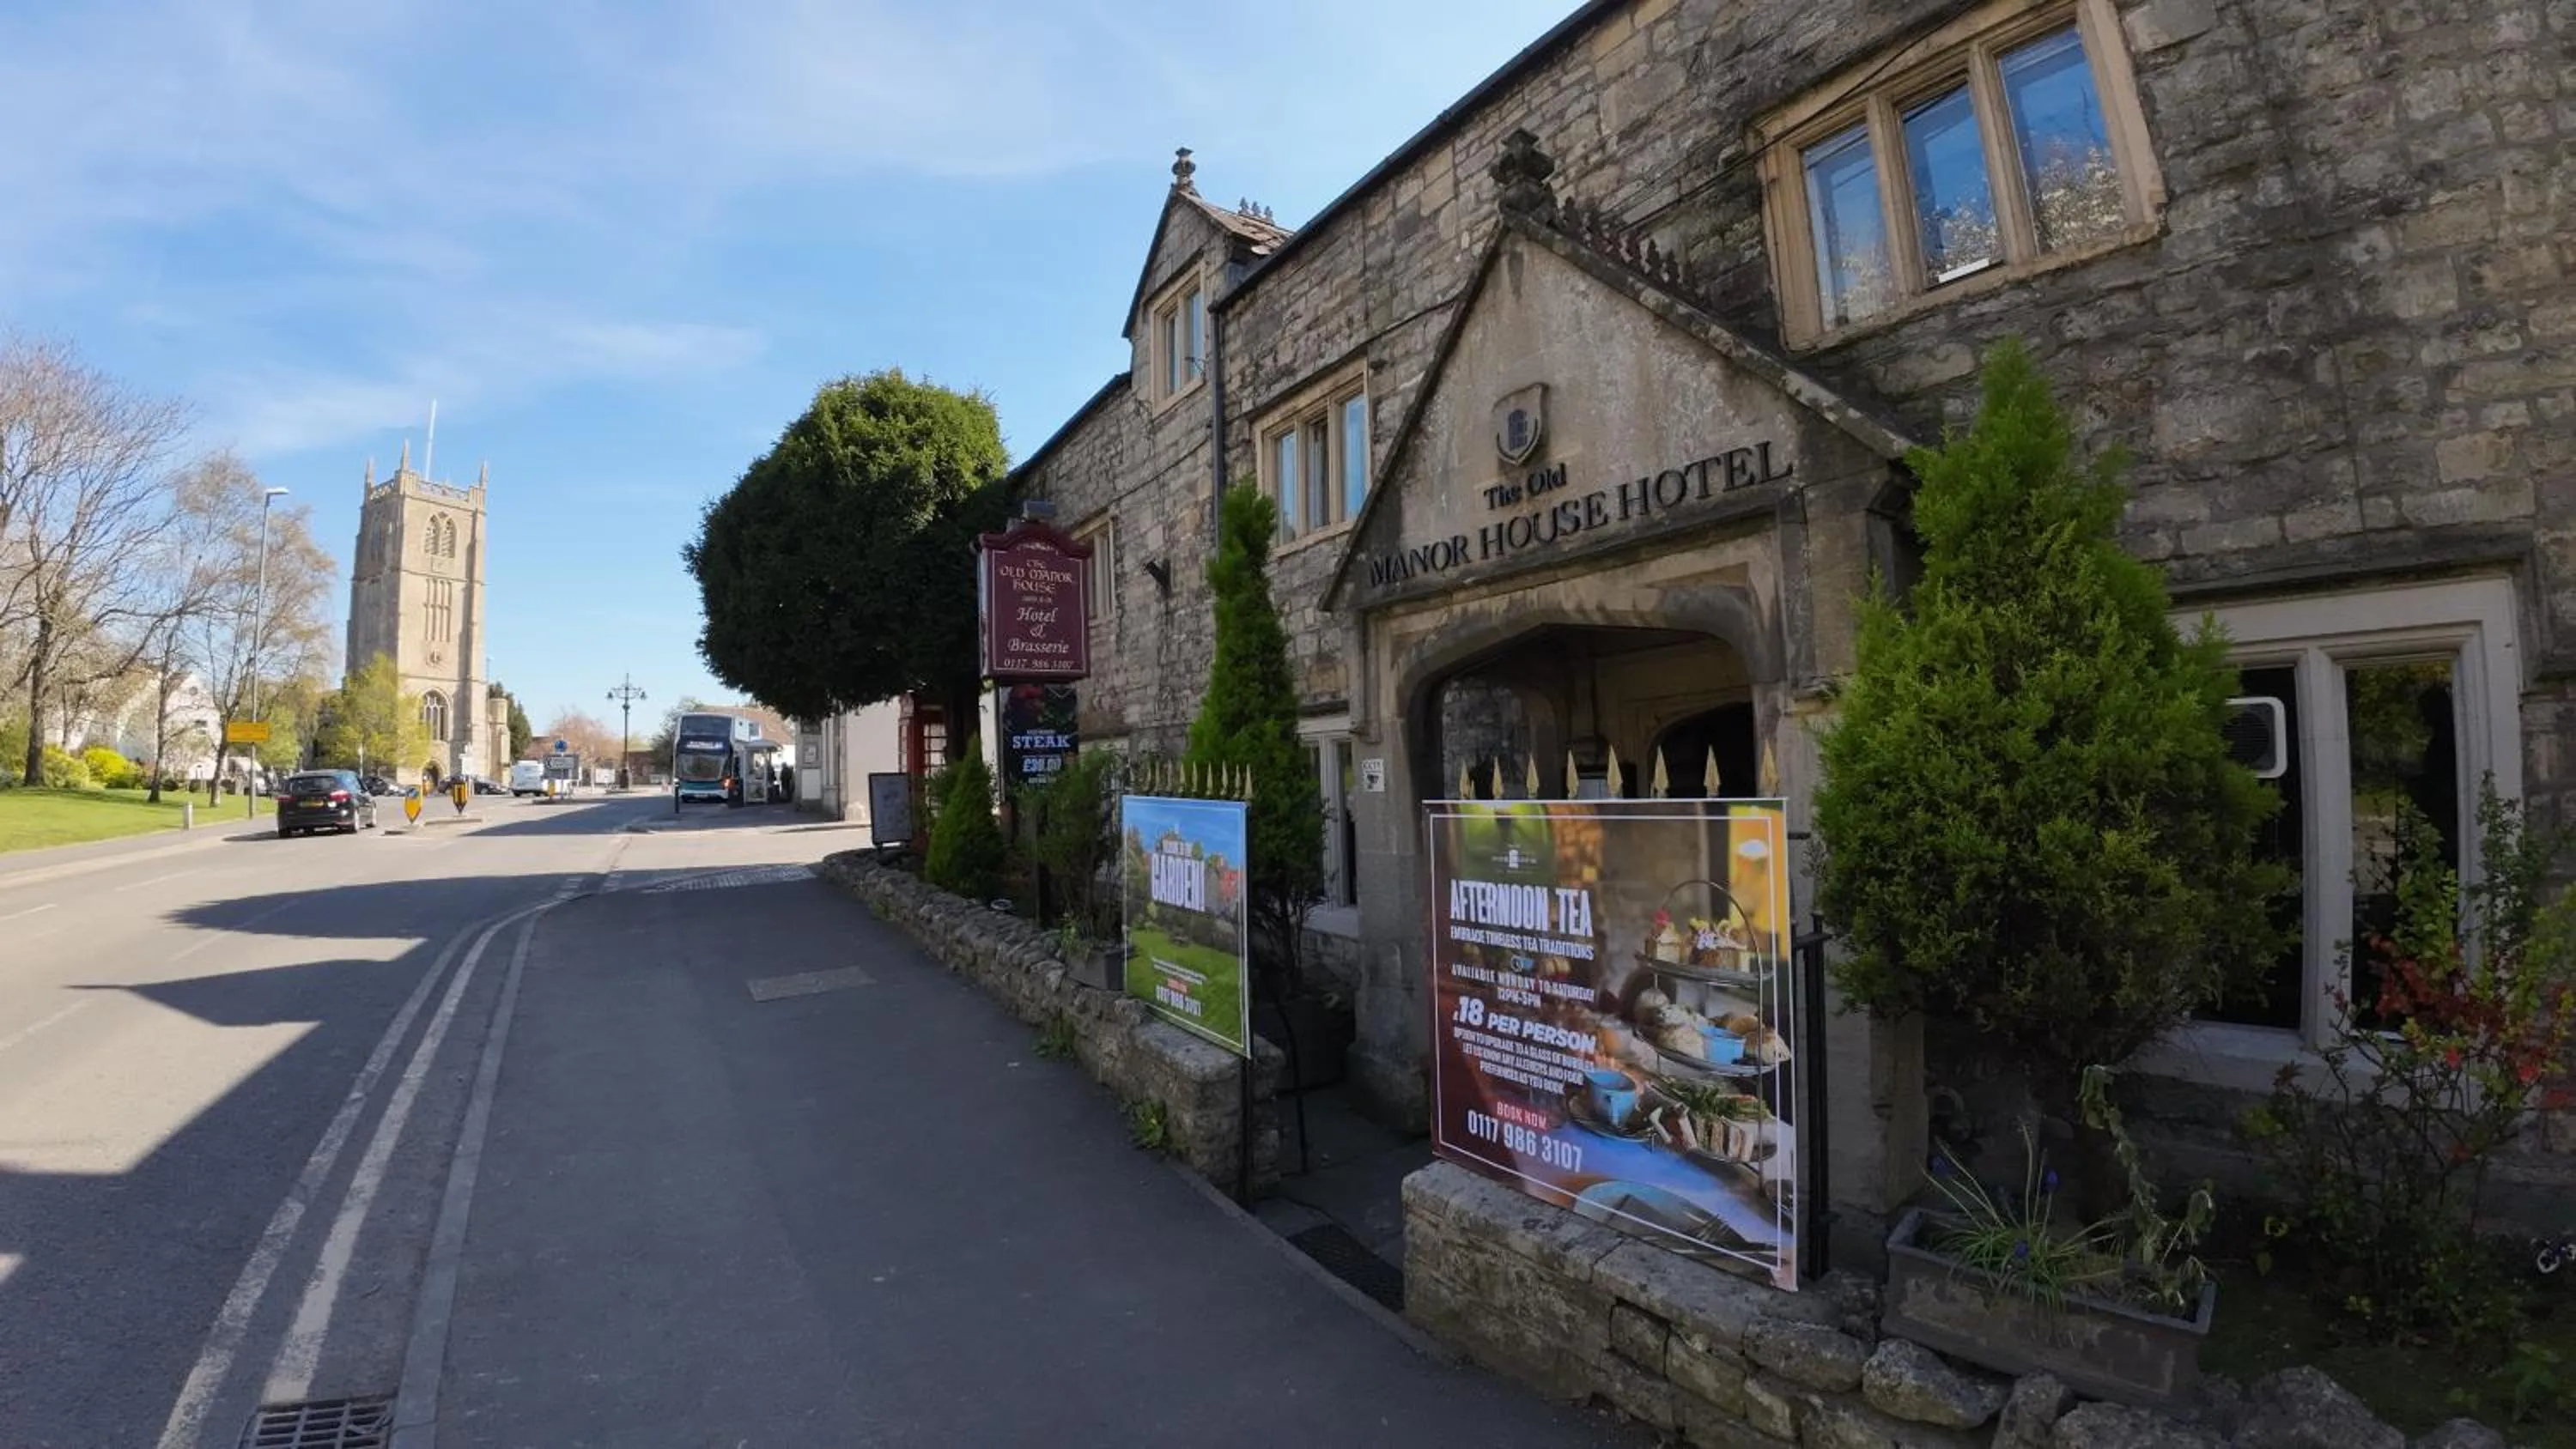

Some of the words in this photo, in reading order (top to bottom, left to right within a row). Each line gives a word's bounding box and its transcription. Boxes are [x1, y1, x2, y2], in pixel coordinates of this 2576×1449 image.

[1483, 485, 1522, 511] The
[1528, 462, 1567, 497] Old
[1370, 535, 1472, 588] MANOR
[1479, 490, 1608, 560] HOUSE
[1617, 440, 1794, 521] HOTEL
[999, 565, 1026, 578] OLD
[1013, 578, 1056, 594] HOUSE
[1016, 607, 1058, 622] Hotel
[1007, 638, 1070, 653] Brasserie
[1012, 735, 1071, 749] STEAK
[1151, 852, 1206, 912] GARDEN
[1450, 878, 1549, 931] AFTERNOON
[1555, 888, 1594, 938] TEA
[1450, 925, 1484, 943] EMBRACE
[1485, 931, 1522, 950] TIMELESS
[1523, 936, 1539, 953] TEA
[1540, 938, 1595, 961] TRADITIONS
[1451, 963, 1495, 983] AVAILABLE
[1498, 971, 1535, 991] MONDAY
[1539, 979, 1551, 994] TO
[1552, 982, 1595, 1003] SATURDAY
[1486, 1012, 1521, 1037] PER
[1522, 1020, 1596, 1055] PERSON
[1497, 1101, 1523, 1123] BOOK
[1524, 1109, 1547, 1130] NOW
[1467, 1109, 1498, 1144] 0117
[1504, 1121, 1536, 1157] 986
[1542, 1134, 1583, 1173] 3107
